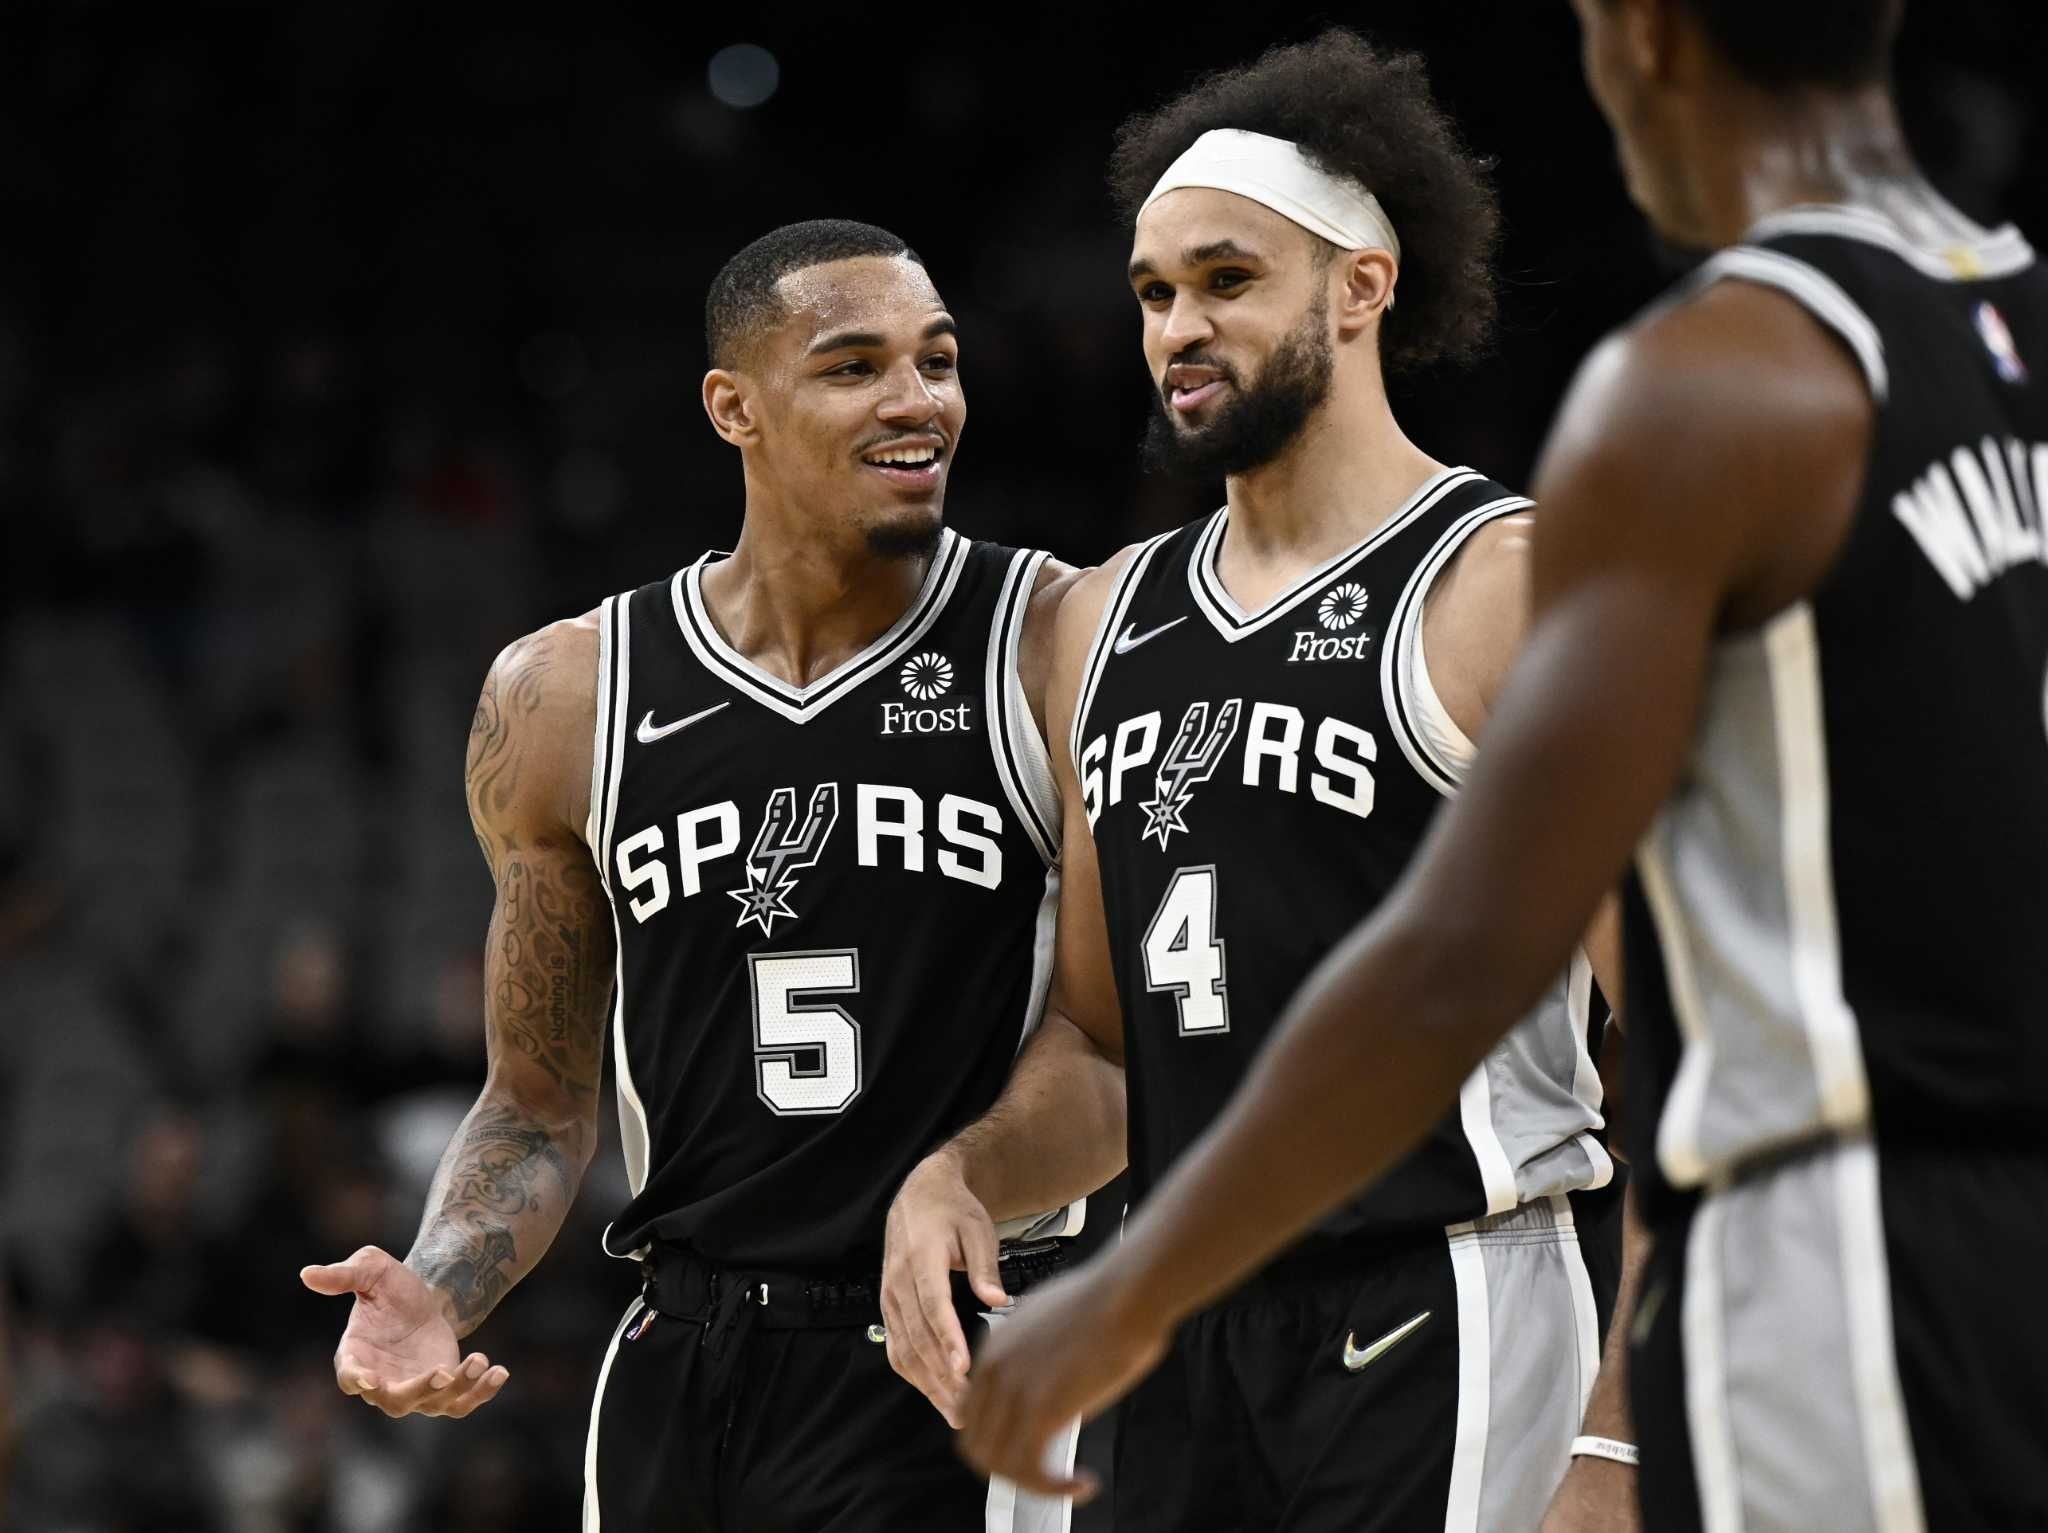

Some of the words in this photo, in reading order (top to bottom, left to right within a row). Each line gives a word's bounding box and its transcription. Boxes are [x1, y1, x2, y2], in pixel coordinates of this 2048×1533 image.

[1287, 630, 1371, 662] Frost
[879, 702, 972, 735] Frost
[1080, 697, 1379, 853] SPURS
[615, 781, 1004, 939] SPURS
[549, 954, 566, 971] is
[1140, 863, 1231, 1038] 4
[549, 975, 569, 1041] Nothing
[747, 947, 863, 1117] 5
